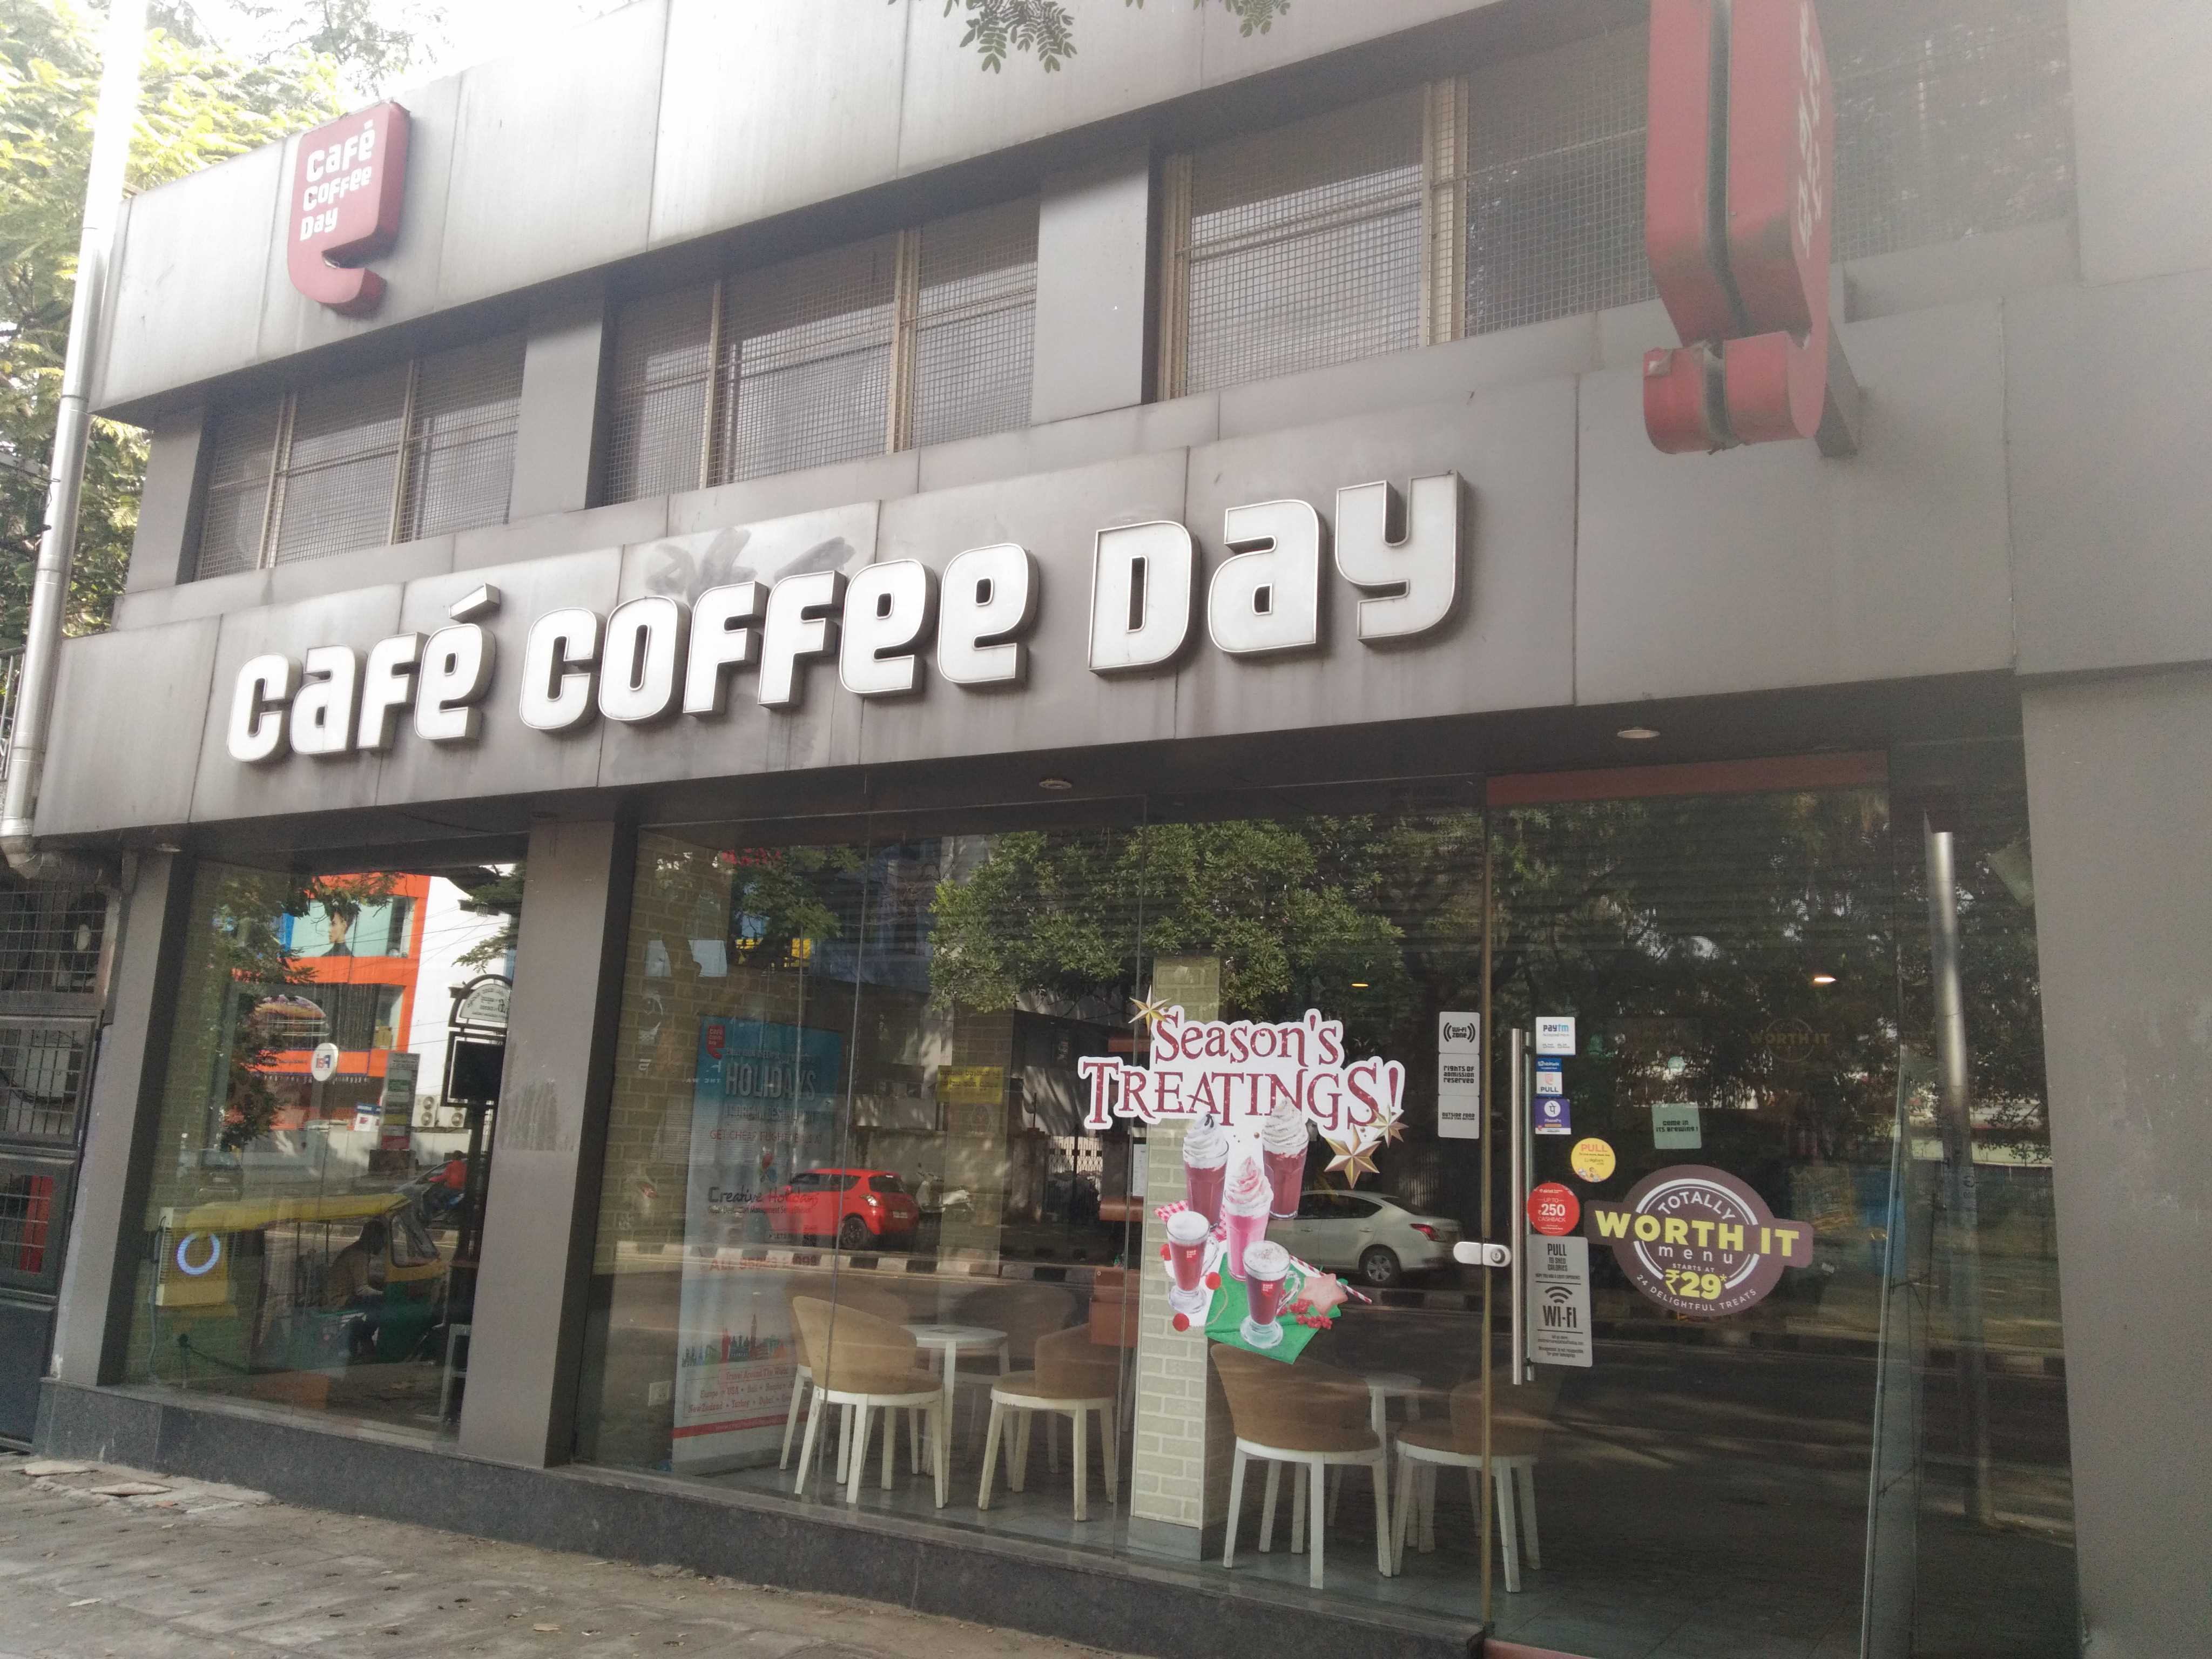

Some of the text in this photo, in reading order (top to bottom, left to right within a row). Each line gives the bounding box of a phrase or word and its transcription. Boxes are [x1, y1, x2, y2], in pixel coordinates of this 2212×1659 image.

[307, 119, 375, 182] Café
[303, 166, 372, 211] Coffee
[300, 207, 338, 241] Day
[1088, 470, 1461, 673] Day
[1155, 1010, 1339, 1068] Season's
[725, 1061, 817, 1102] HOLIDAYS
[1083, 1062, 1399, 1132] TREATINGS!
[1581, 1144, 1607, 1152] PULL
[1657, 1191, 1737, 1221] TOTALLY
[1547, 1243, 1567, 1256] PULL
[1595, 1210, 1799, 1257] WORTH IT
[1658, 1245, 1734, 1264] menu
[1672, 1263, 1702, 1271] STARTS
[1637, 1274, 1757, 1311] 24 DELIGHTFUL TREATS
[1543, 1305, 1577, 1328] WI-FI
